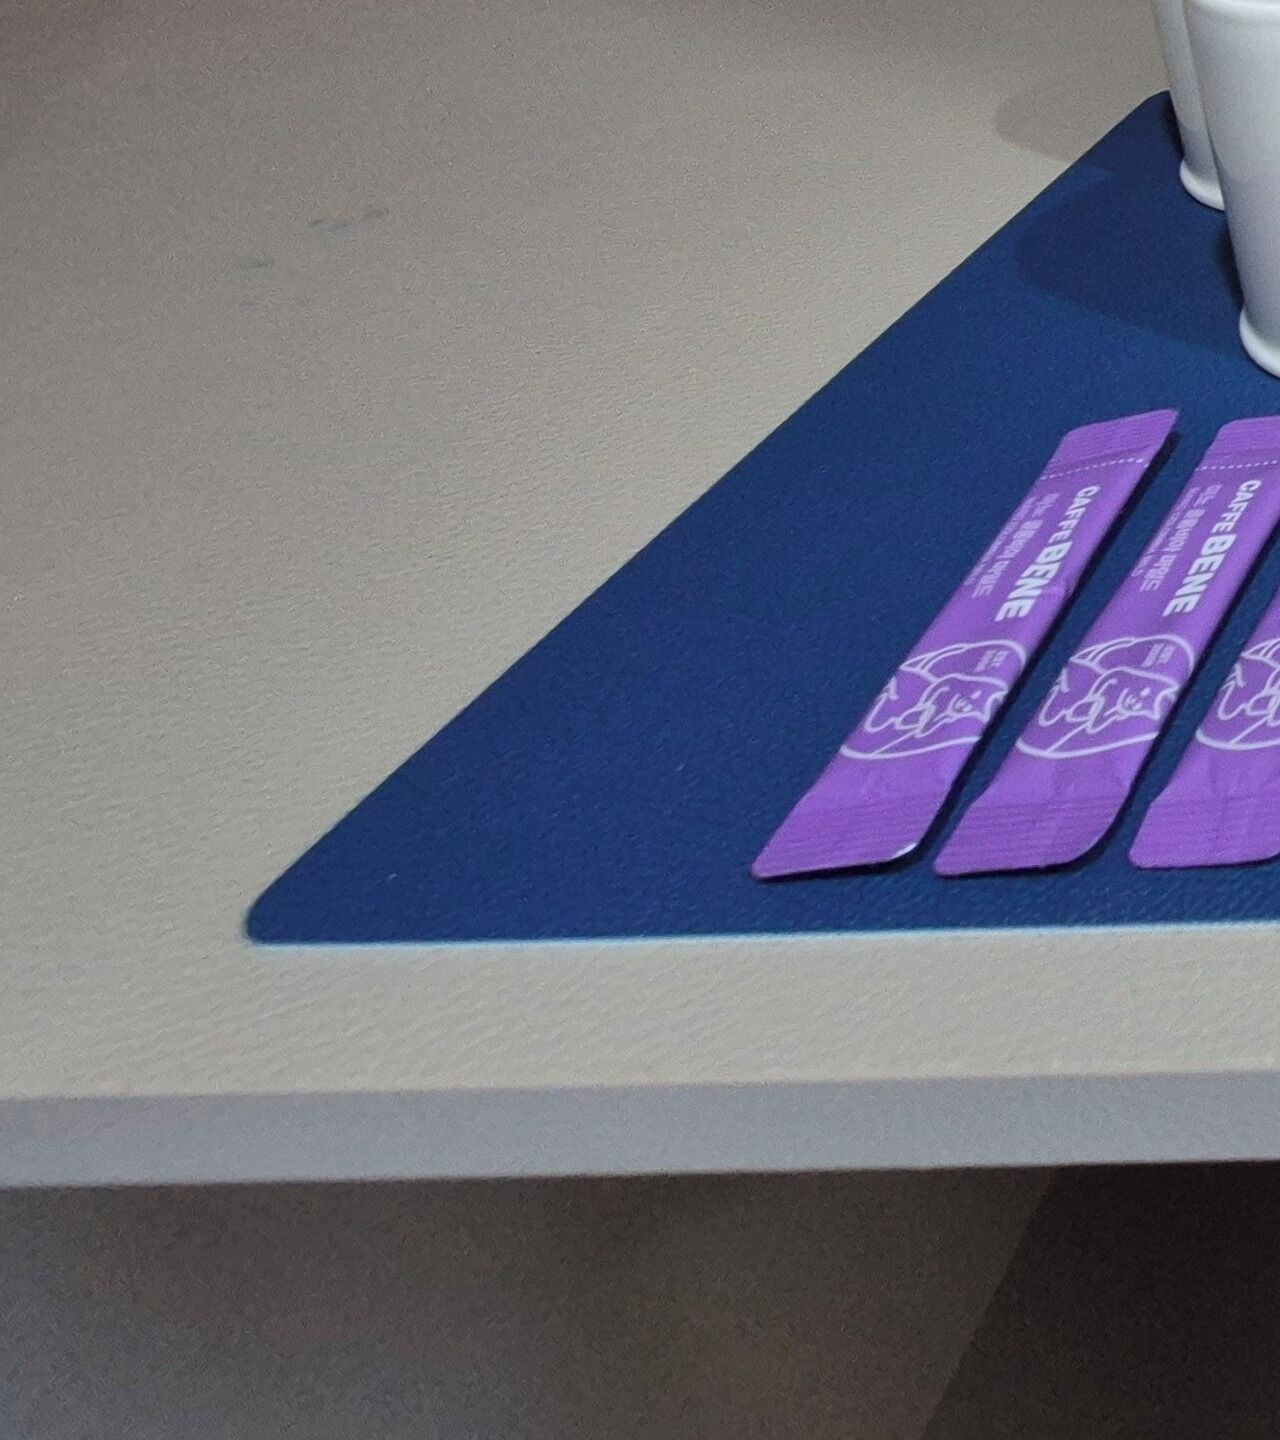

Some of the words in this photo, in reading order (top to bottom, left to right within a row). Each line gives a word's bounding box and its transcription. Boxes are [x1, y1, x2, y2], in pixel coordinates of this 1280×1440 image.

[1048, 485, 1101, 543] CAFFE
[1212, 480, 1262, 533] CAFFE
[994, 541, 1073, 622] BENE
[1162, 534, 1237, 617] BENE
